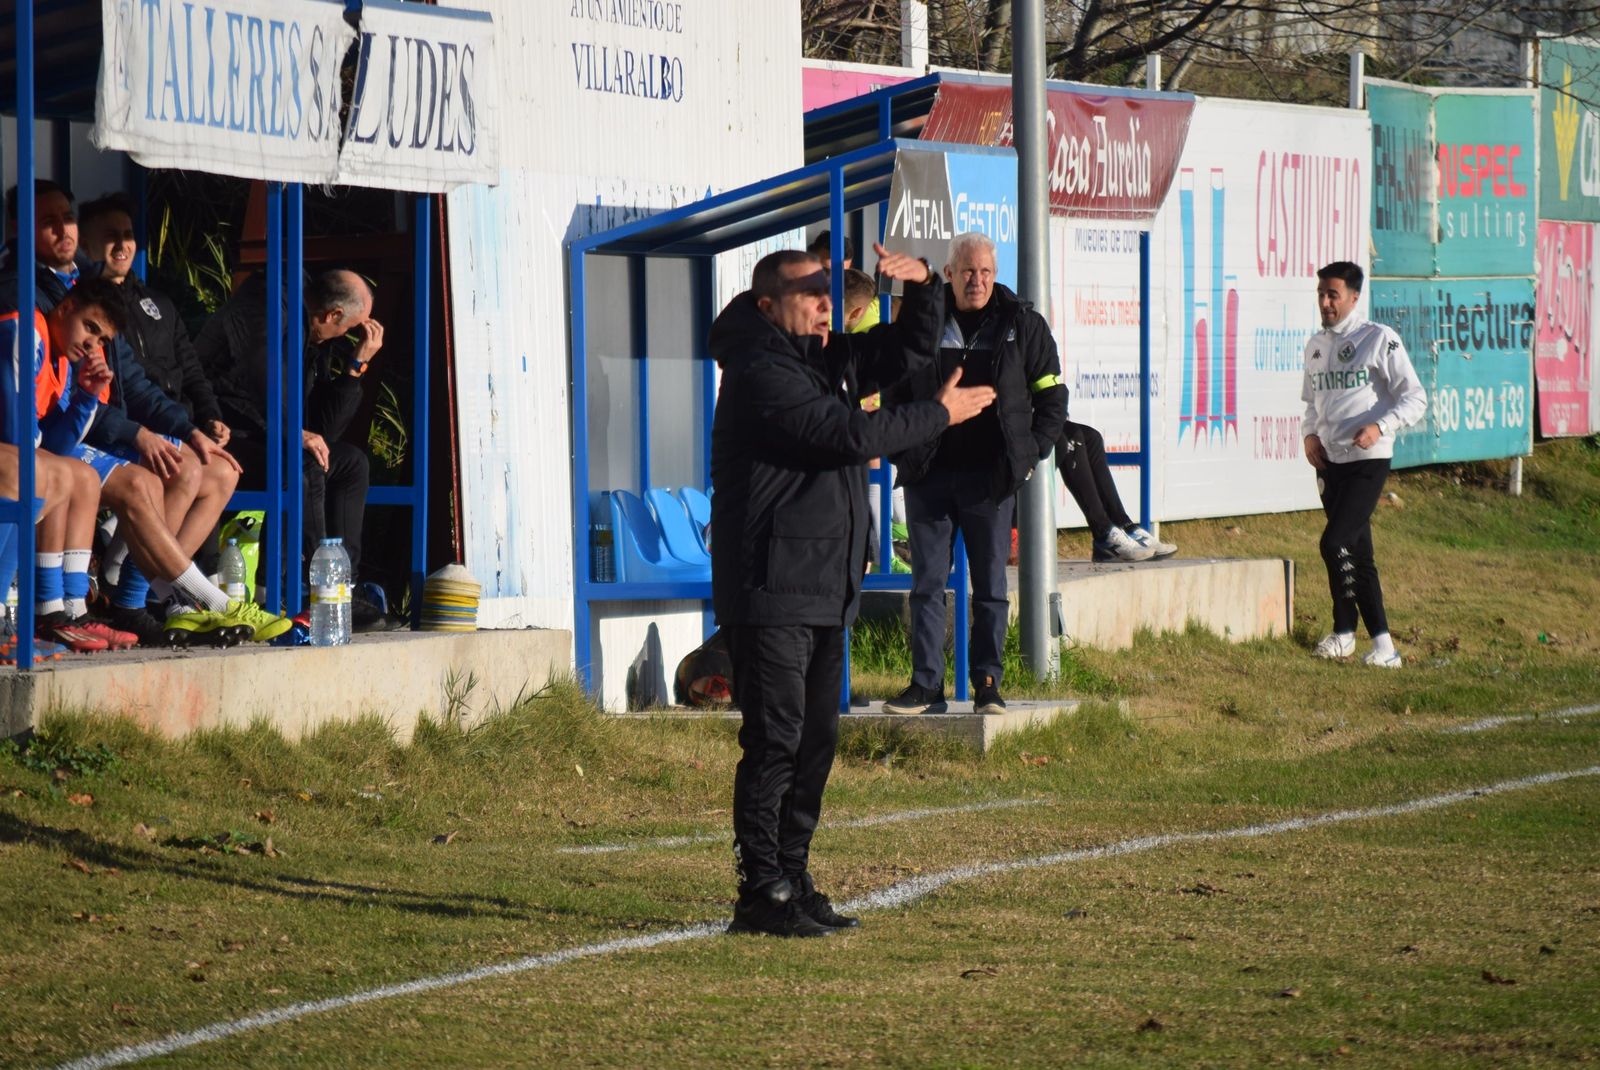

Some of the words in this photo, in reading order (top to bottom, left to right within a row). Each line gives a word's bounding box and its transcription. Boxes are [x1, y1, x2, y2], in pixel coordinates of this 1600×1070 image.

[666, 2, 683, 34] DE
[141, 0, 301, 141] TALLERES
[571, 42, 684, 104] VILLARALBO
[1091, 115, 1152, 199] Aurelia
[890, 188, 952, 240] METAL
[1464, 386, 1495, 431] 524
[1500, 384, 1525, 429] 133
